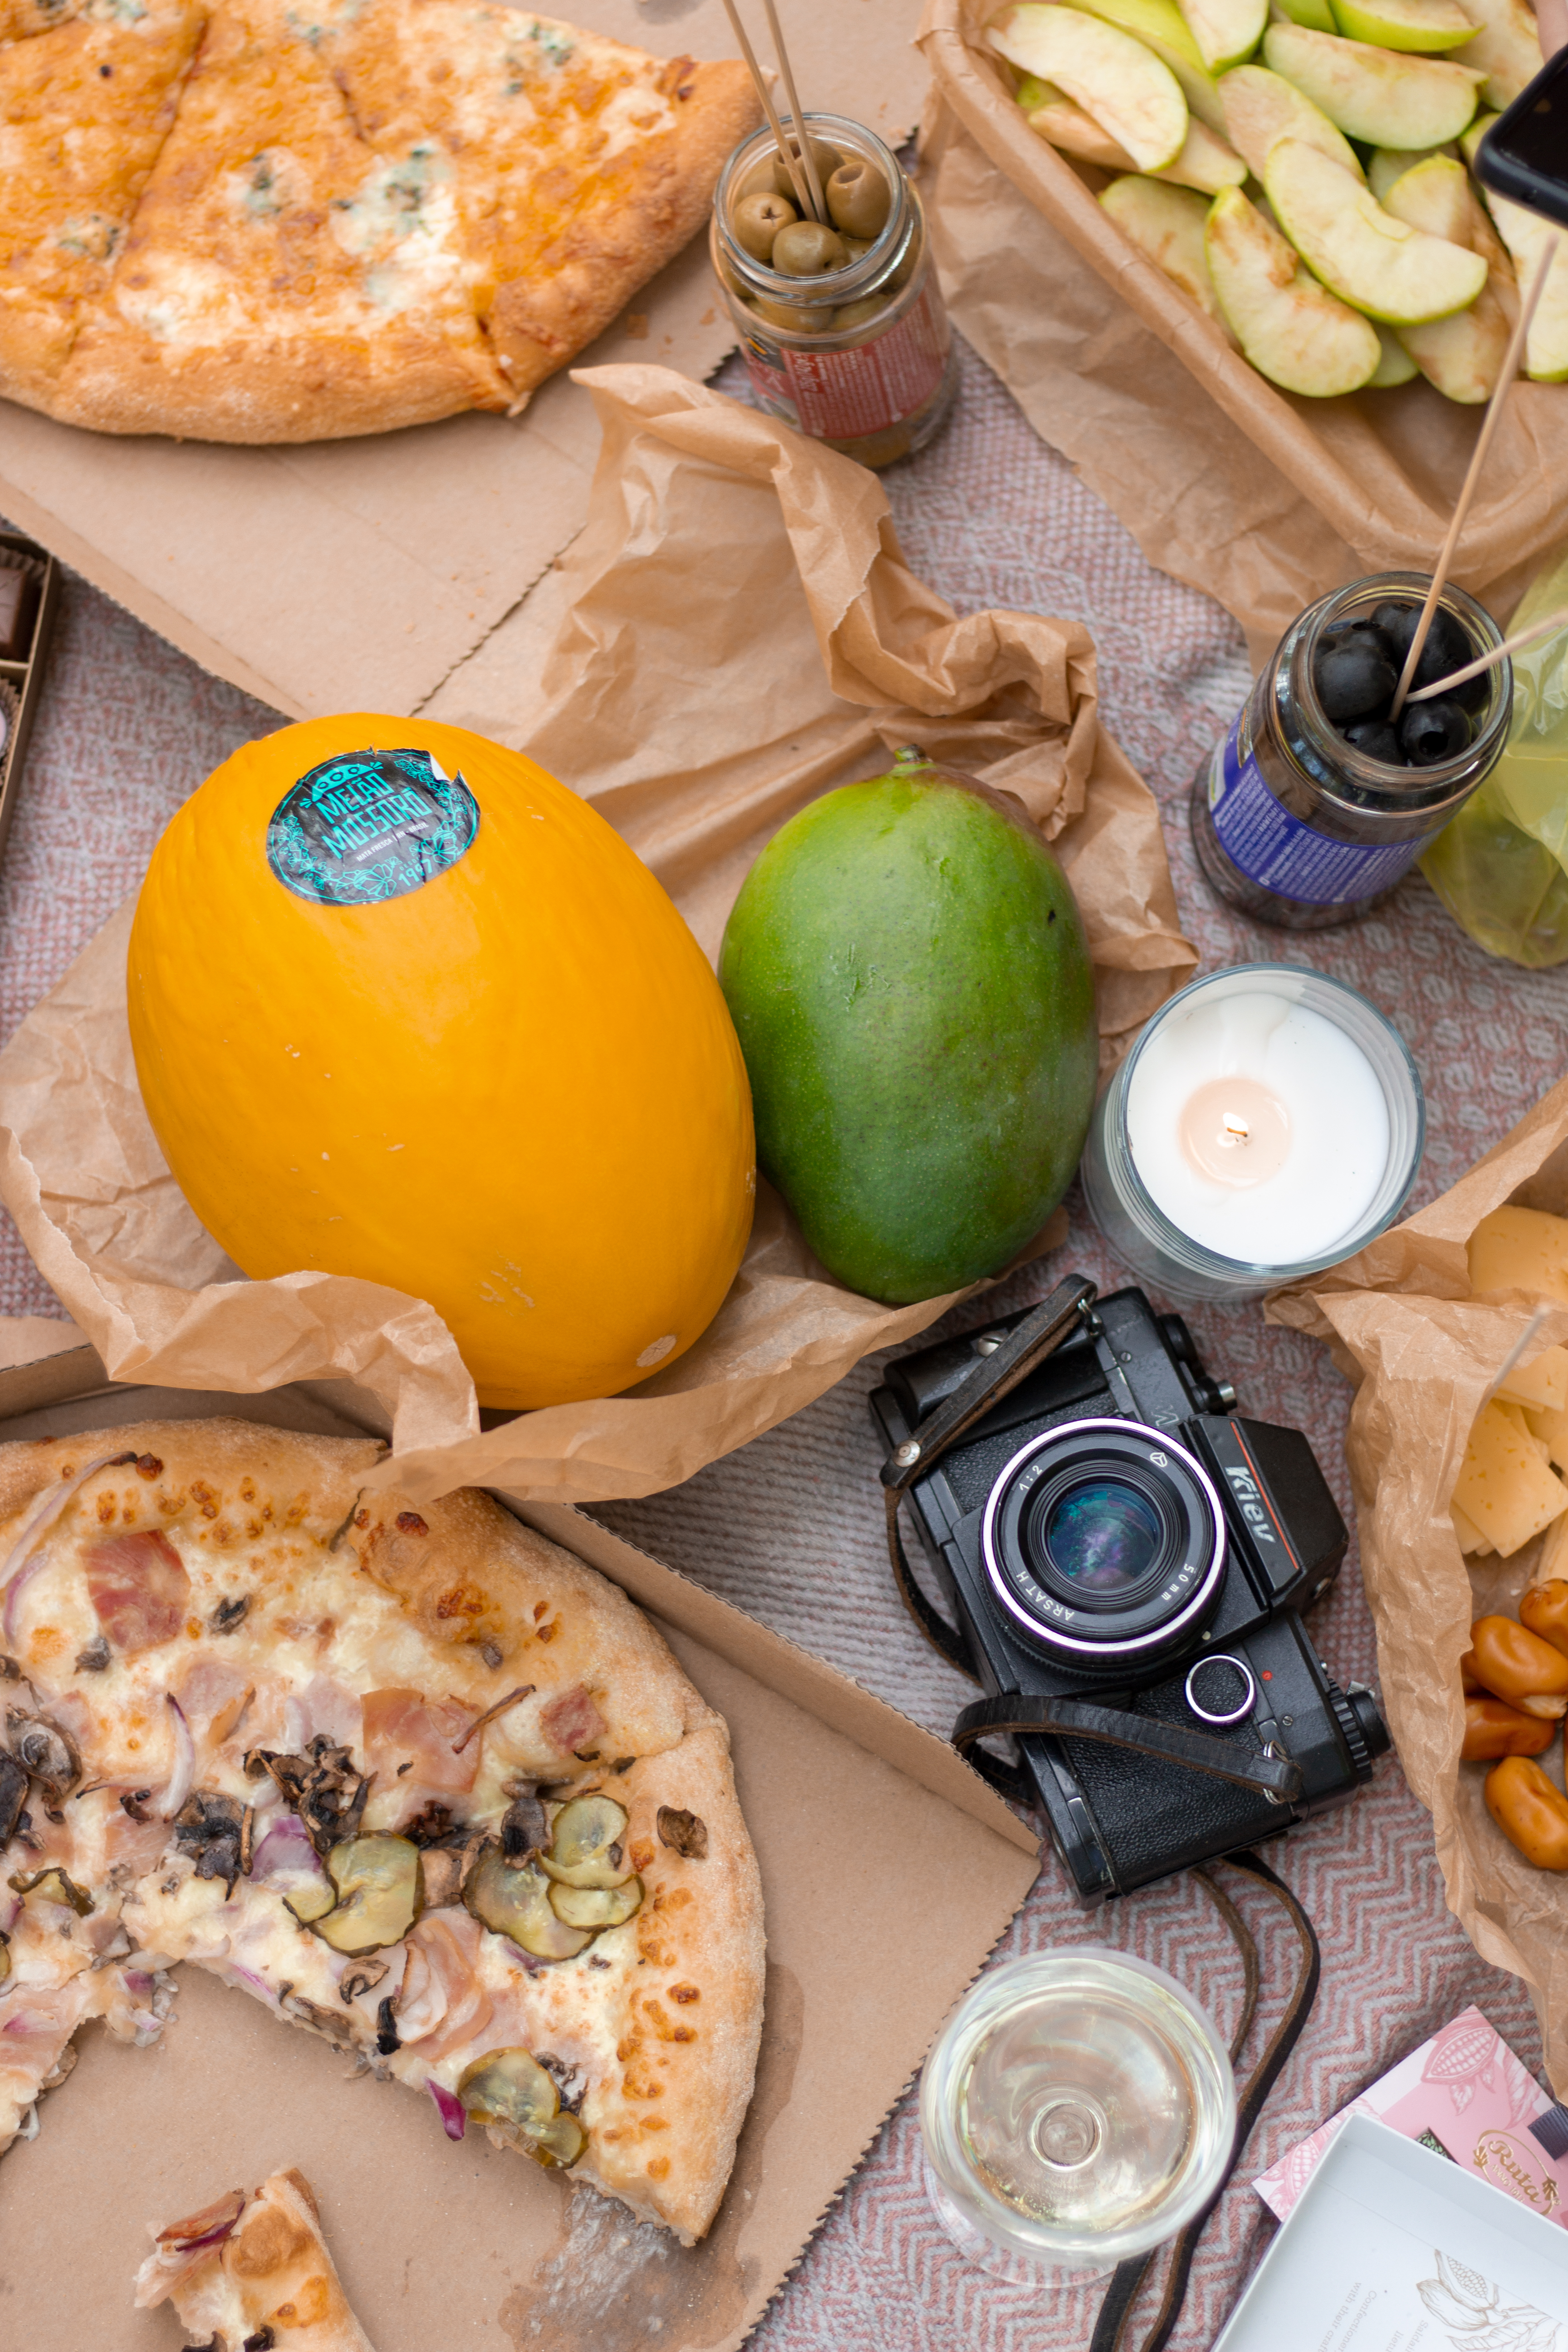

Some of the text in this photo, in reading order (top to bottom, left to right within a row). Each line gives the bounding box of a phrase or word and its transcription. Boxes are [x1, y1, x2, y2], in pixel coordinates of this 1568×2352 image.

[316, 772, 394, 824] MELÃO
[321, 787, 433, 859] MOSSORÓ
[356, 850, 373, 862] MATA
[371, 838, 393, 853] FRESCA
[396, 831, 406, 839] RN
[408, 822, 429, 833] BRASIL
[398, 858, 432, 886] 1997
[1019, 1465, 1043, 1490] 1:2
[1225, 1466, 1276, 1543] Kiev
[1025, 1585, 1075, 1621] ARSAT
[1490, 2164, 1511, 2186] ANNO
[1345, 2282, 1362, 2303] with
[1332, 2305, 1349, 2329] their
[1335, 2290, 1377, 2352] Confectioner
